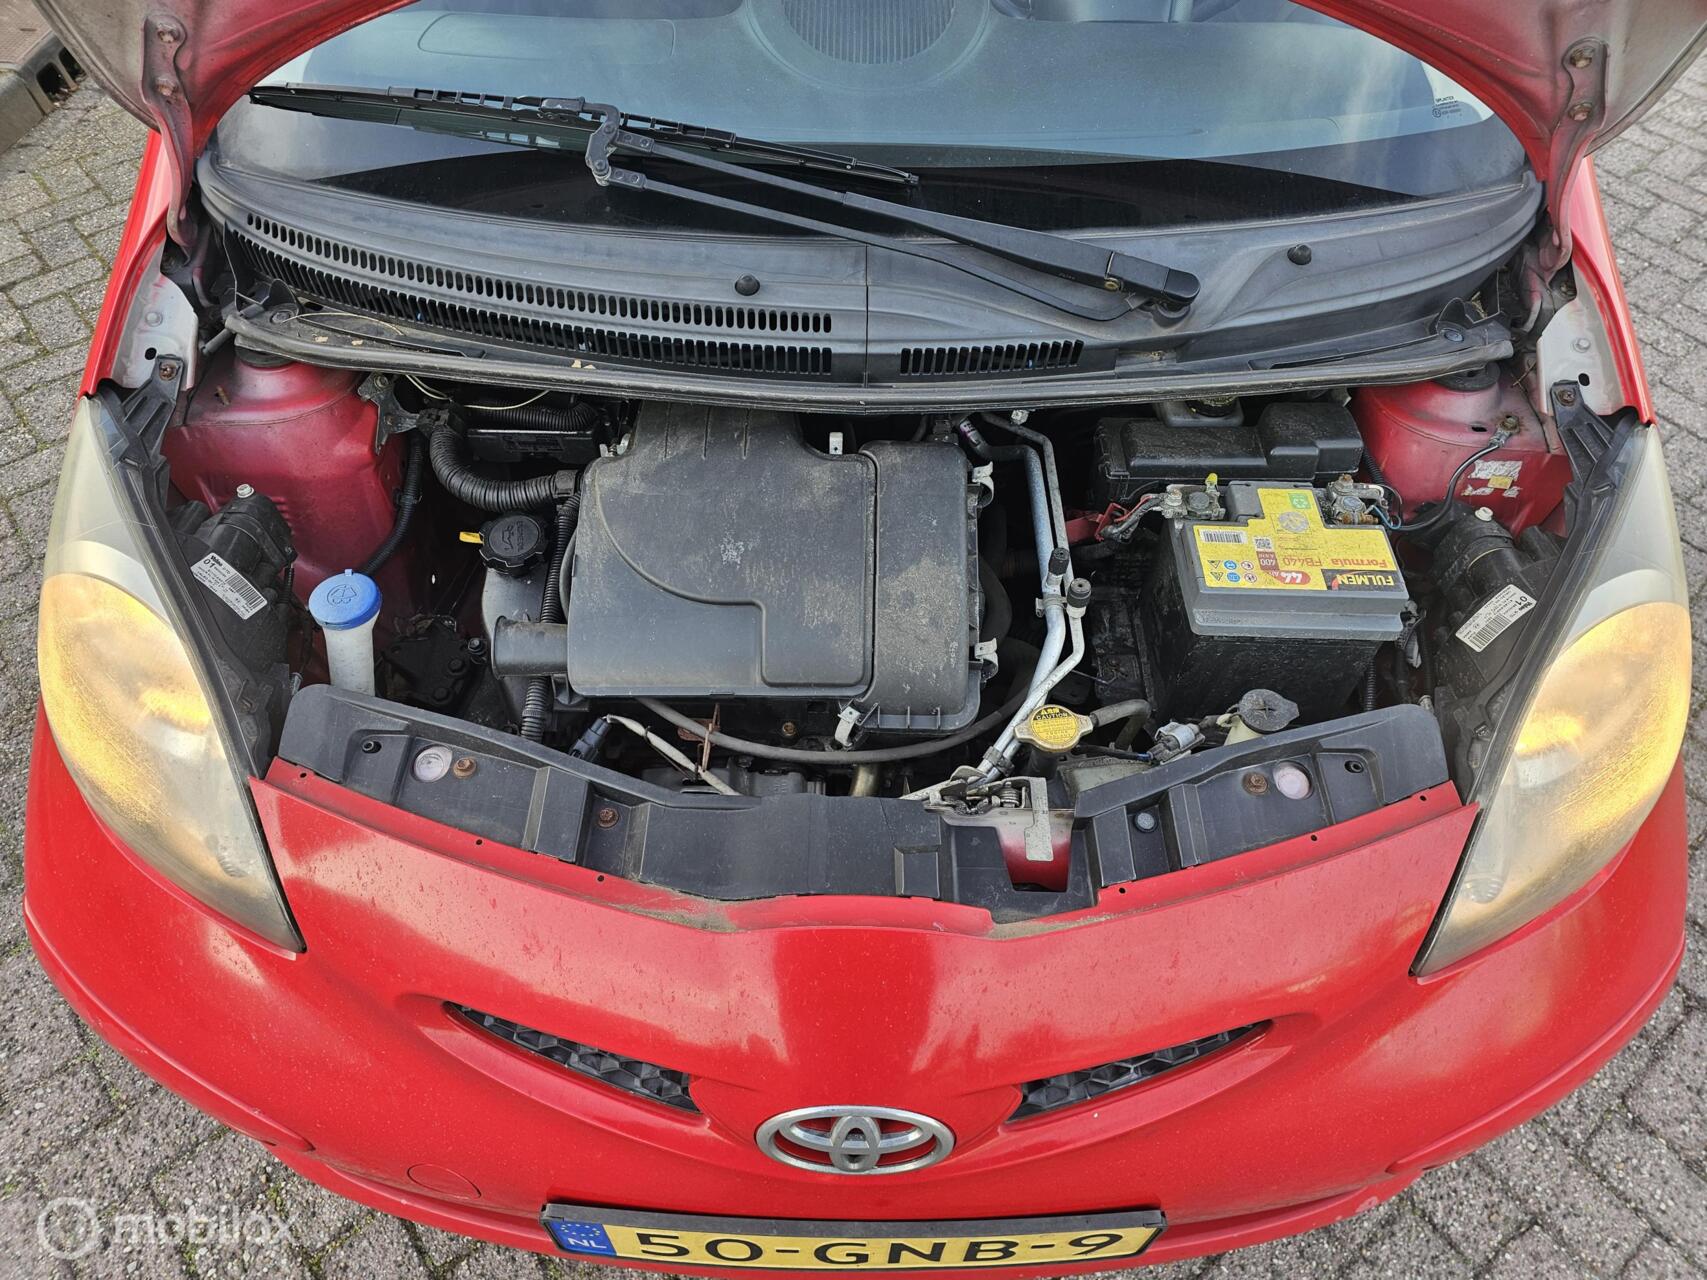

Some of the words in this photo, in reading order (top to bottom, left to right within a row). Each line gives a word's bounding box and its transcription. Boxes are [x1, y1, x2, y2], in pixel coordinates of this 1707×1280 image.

[1283, 557, 1322, 567] FB440
[1332, 558, 1388, 568] Formula
[1281, 572, 1303, 583] 44
[1338, 574, 1394, 586] FULMEN
[1036, 712, 1067, 720] CAUTION
[567, 1237, 607, 1249] NL
[636, 1232, 1123, 1264] 50-GNB-9
